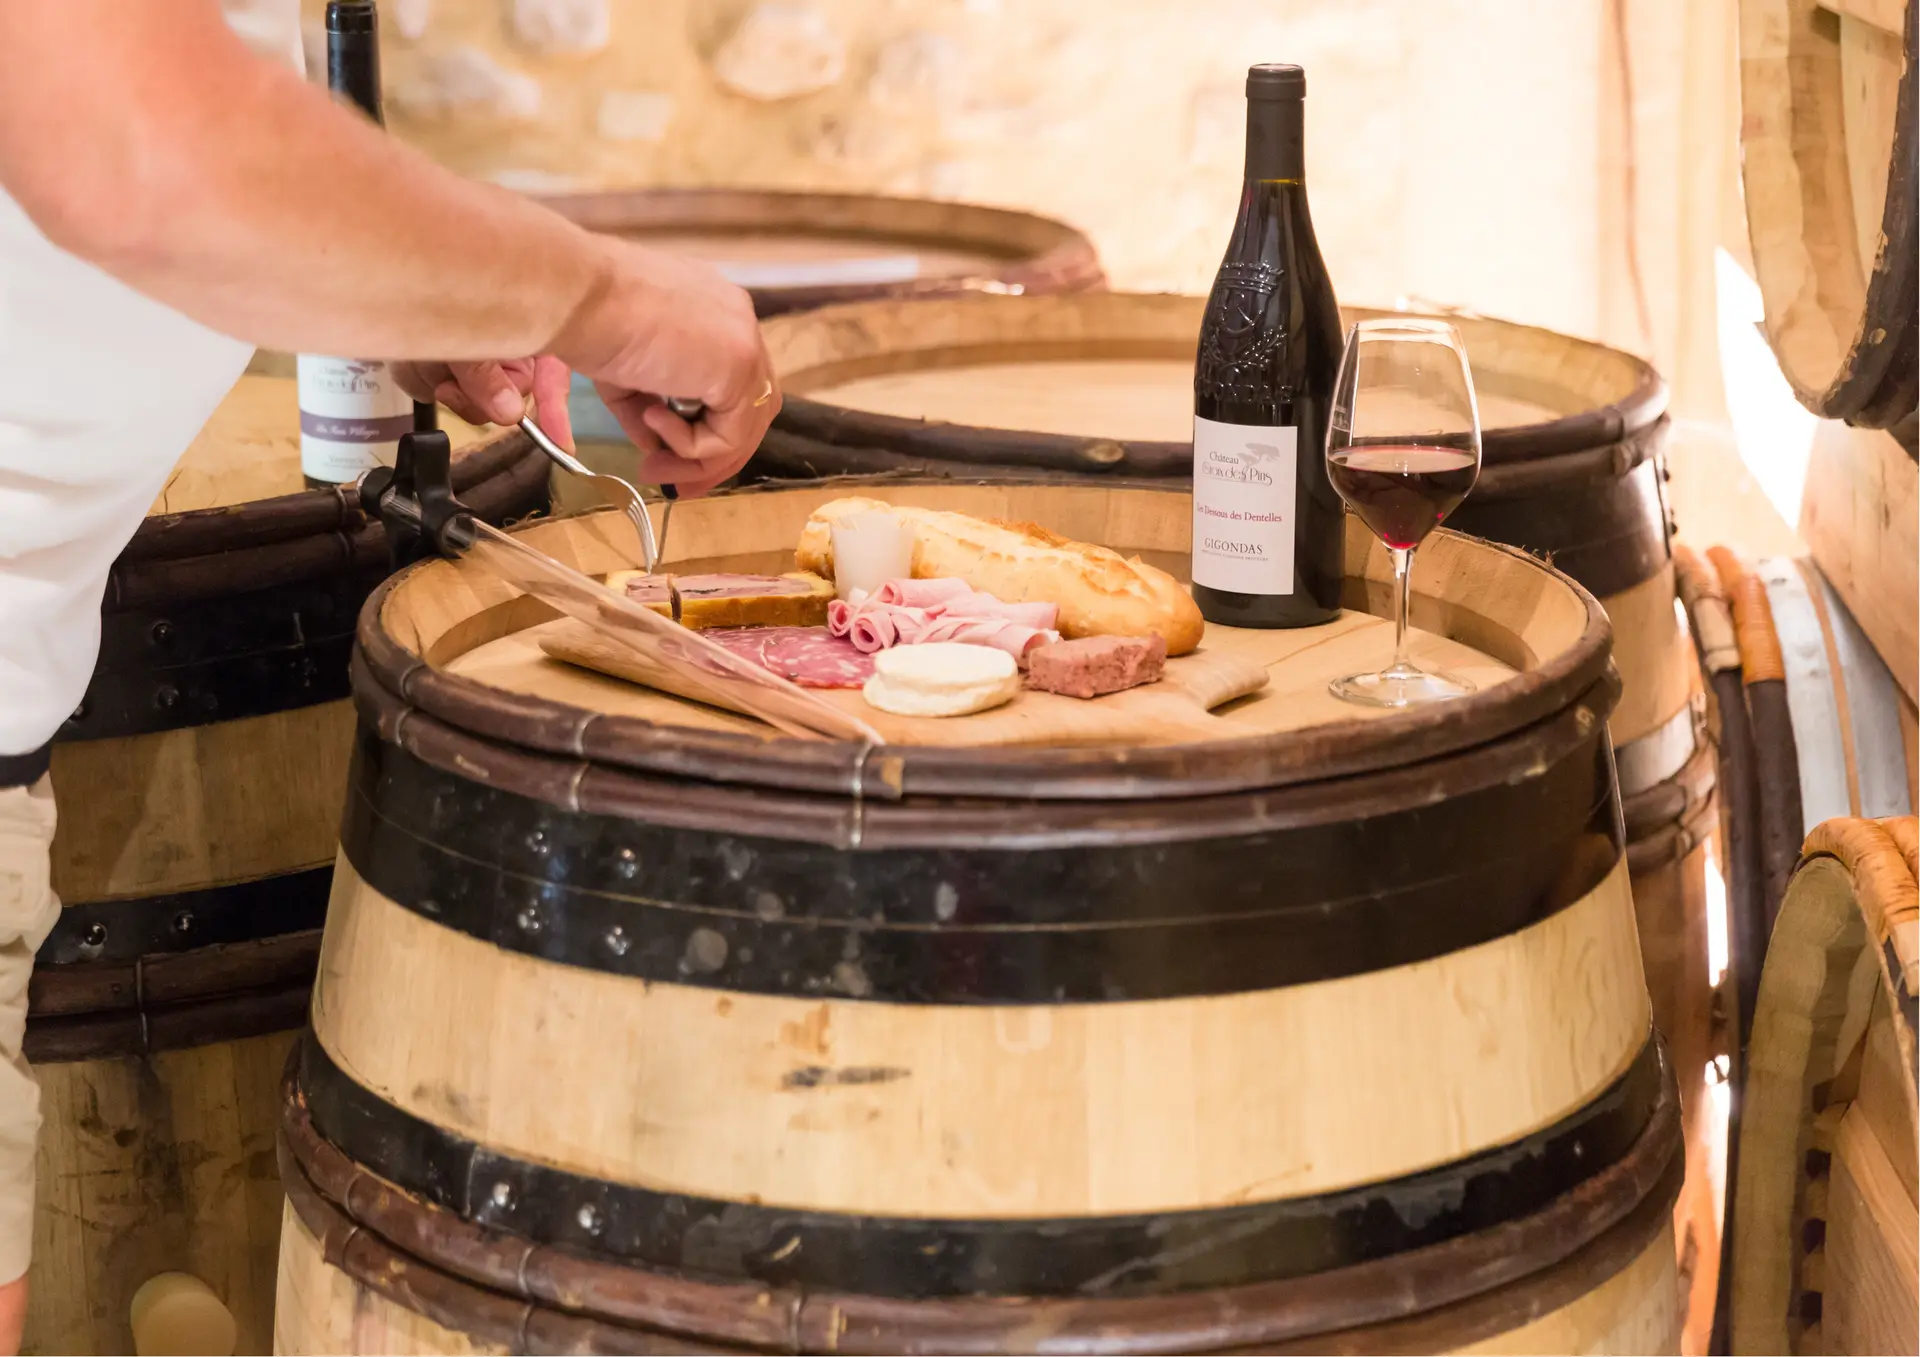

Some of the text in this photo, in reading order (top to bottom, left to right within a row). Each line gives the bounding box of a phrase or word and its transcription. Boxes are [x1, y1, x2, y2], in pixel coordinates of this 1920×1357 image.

[1209, 451, 1239, 464] Château
[1249, 468, 1273, 486] Pins
[1229, 511, 1242, 521] des
[1244, 511, 1282, 522] Dentelles
[1204, 537, 1263, 555] GIGONDAS
